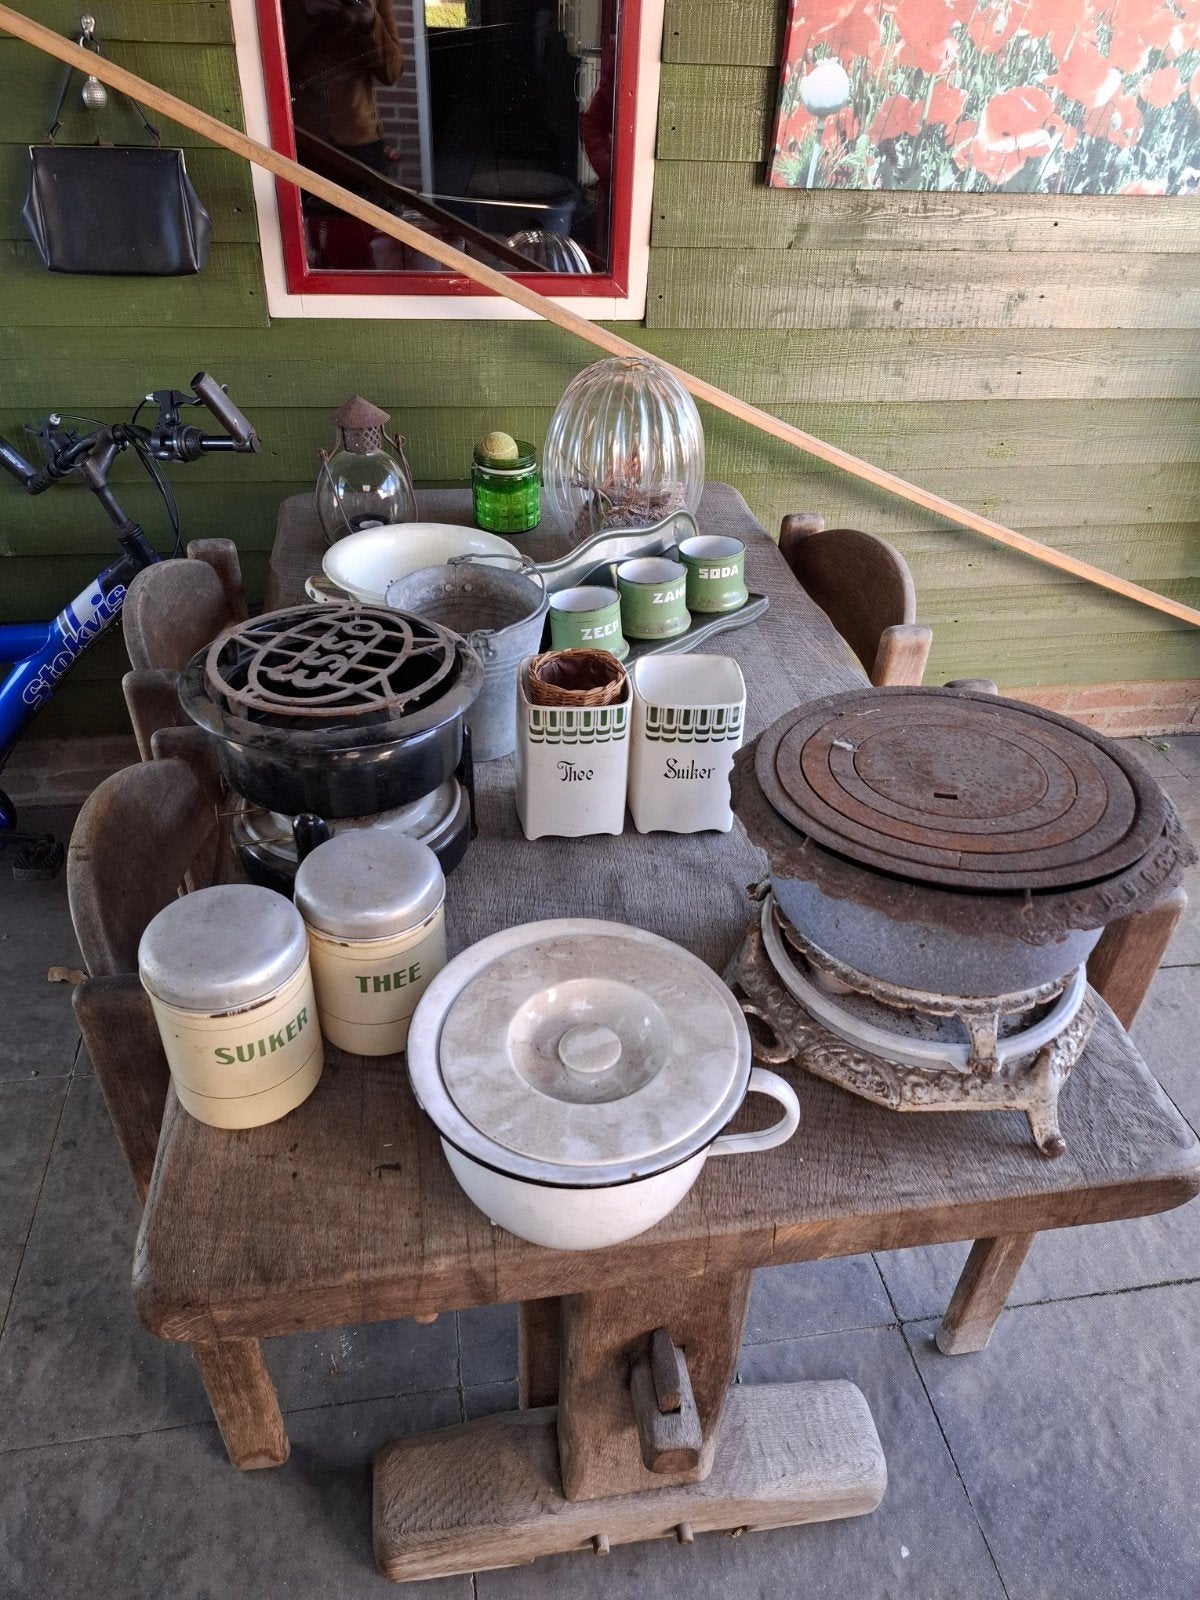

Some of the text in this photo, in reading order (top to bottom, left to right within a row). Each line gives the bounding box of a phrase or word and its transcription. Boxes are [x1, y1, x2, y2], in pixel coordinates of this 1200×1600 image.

[699, 564, 738, 580] SODA
[580, 619, 619, 640] ZEEP
[23, 584, 127, 710] Stokvis
[556, 760, 594, 782] Thee
[663, 757, 716, 780] Suiker
[355, 962, 422, 994] THEE
[214, 1006, 309, 1065] SUIKER
